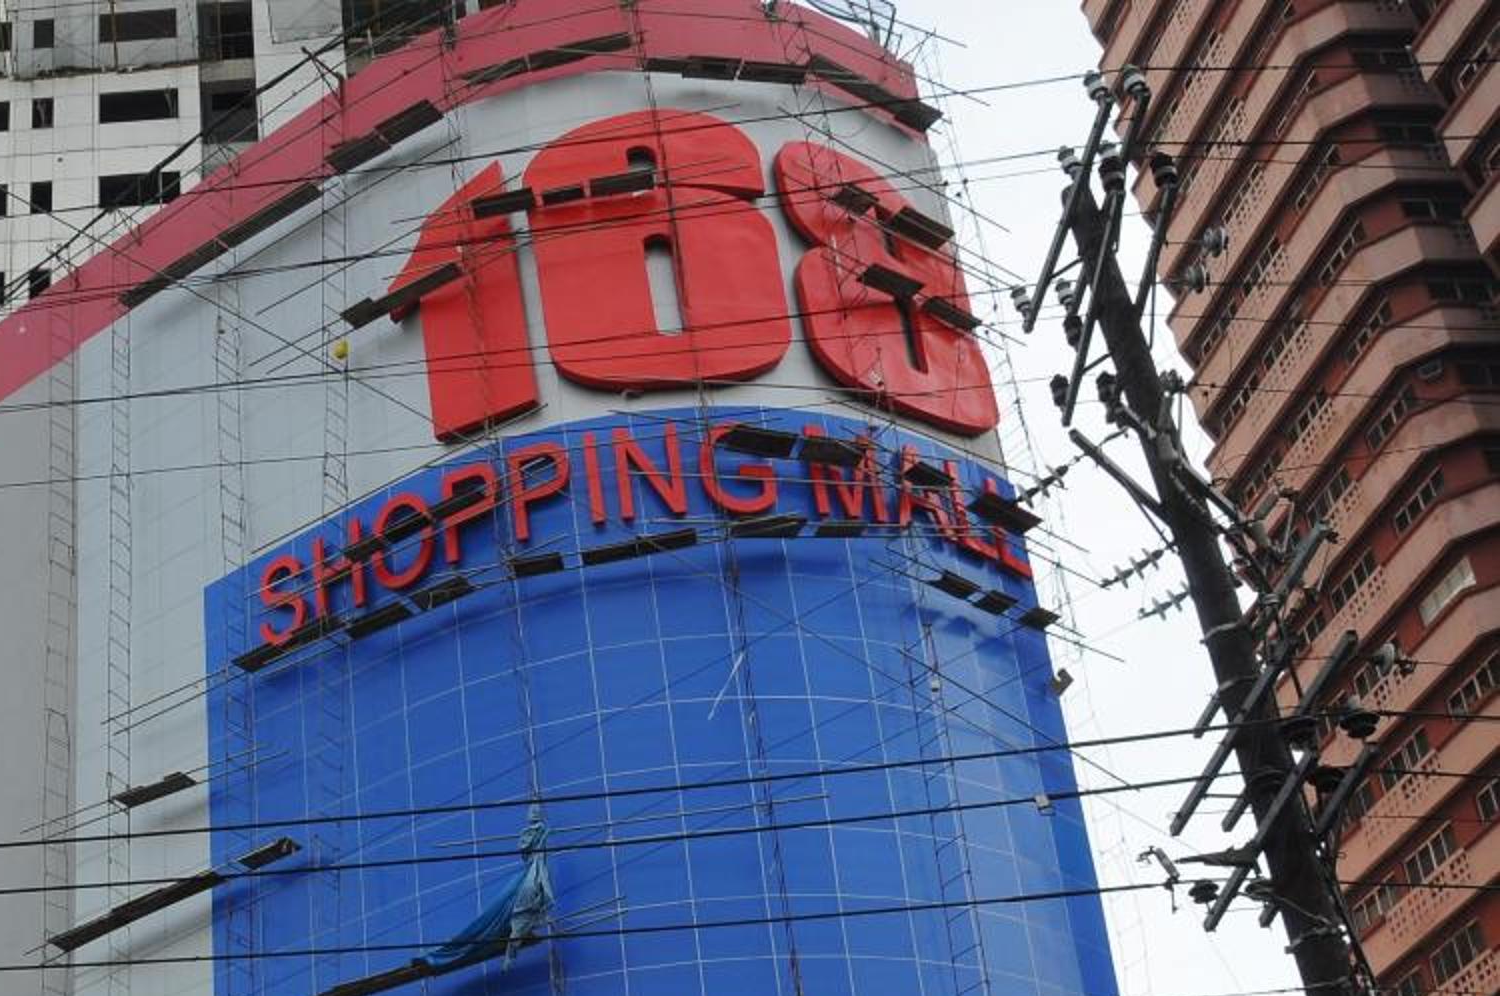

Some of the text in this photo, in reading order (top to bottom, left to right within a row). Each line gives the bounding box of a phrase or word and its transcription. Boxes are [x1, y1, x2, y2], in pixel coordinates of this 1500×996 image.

[388, 107, 1001, 441] 168
[258, 420, 1034, 648] SHOPPING MALL
